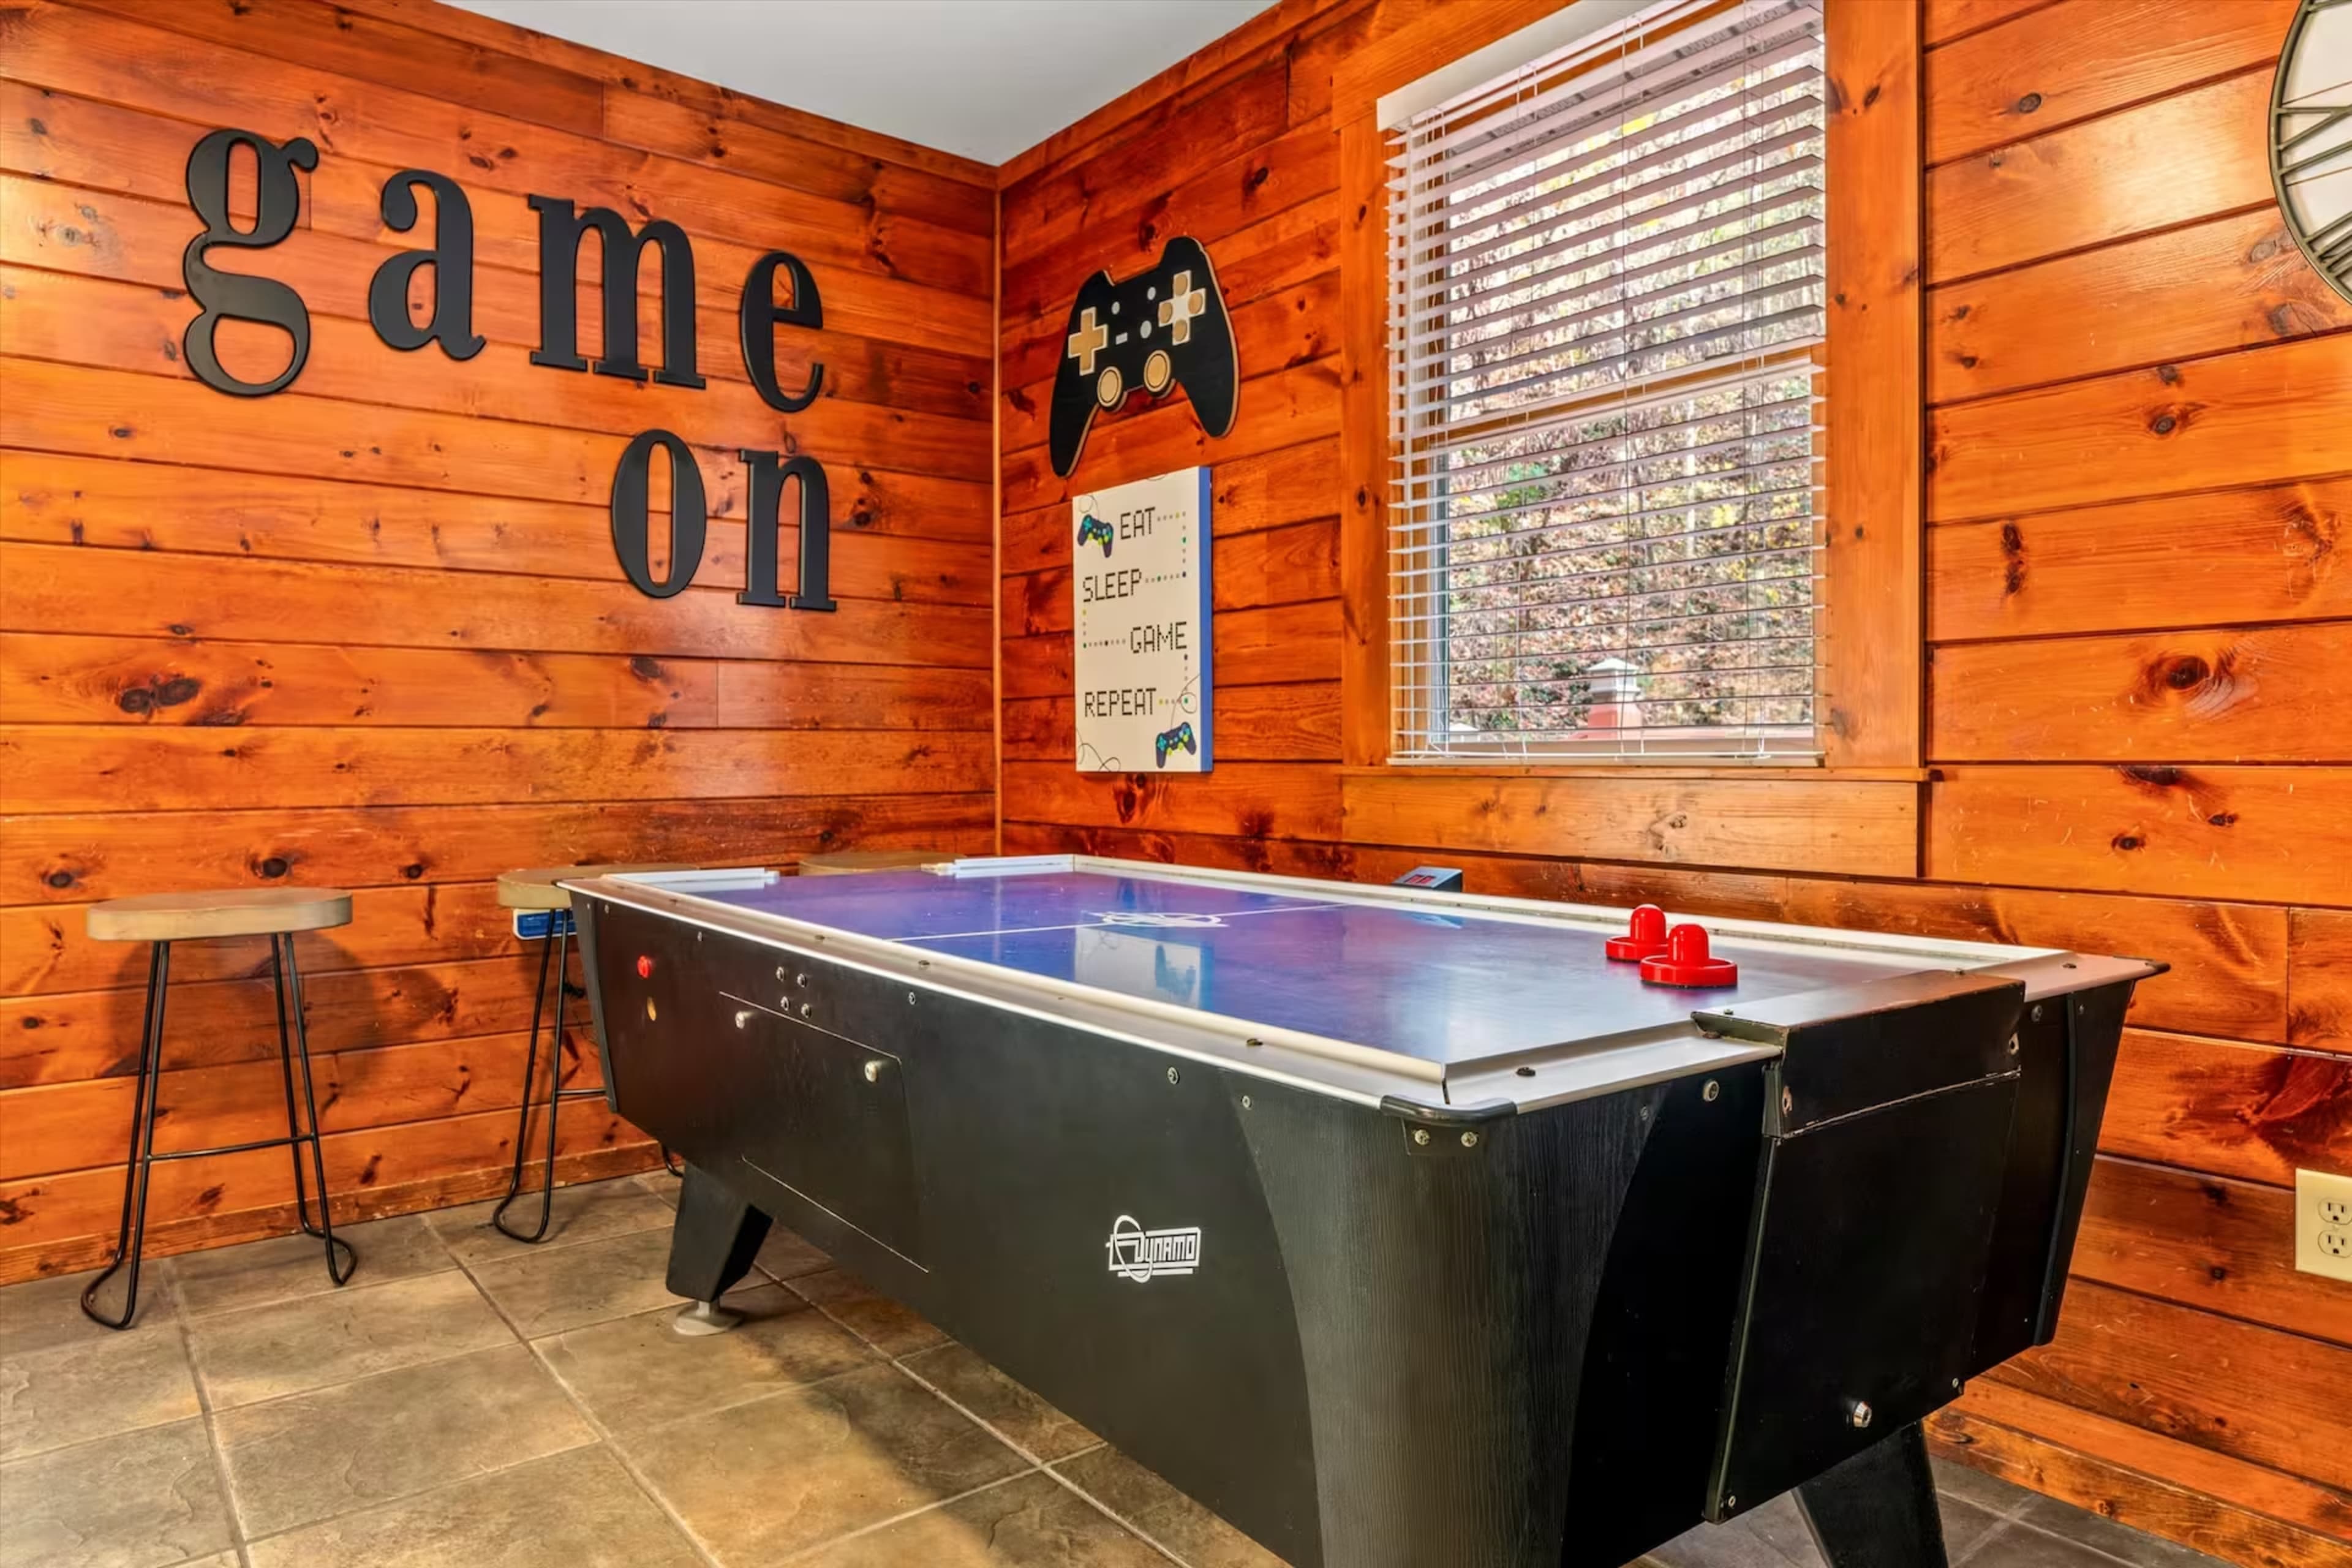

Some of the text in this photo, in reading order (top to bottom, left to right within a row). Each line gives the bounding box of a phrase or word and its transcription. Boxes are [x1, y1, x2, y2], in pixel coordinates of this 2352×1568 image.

[183, 128, 824, 412] game
[610, 429, 837, 612] on
[1120, 507, 1156, 540] EAT
[1082, 568, 1142, 603] SLEEP
[1130, 621, 1188, 654] GAME
[1084, 687, 1157, 717] REPEAT
